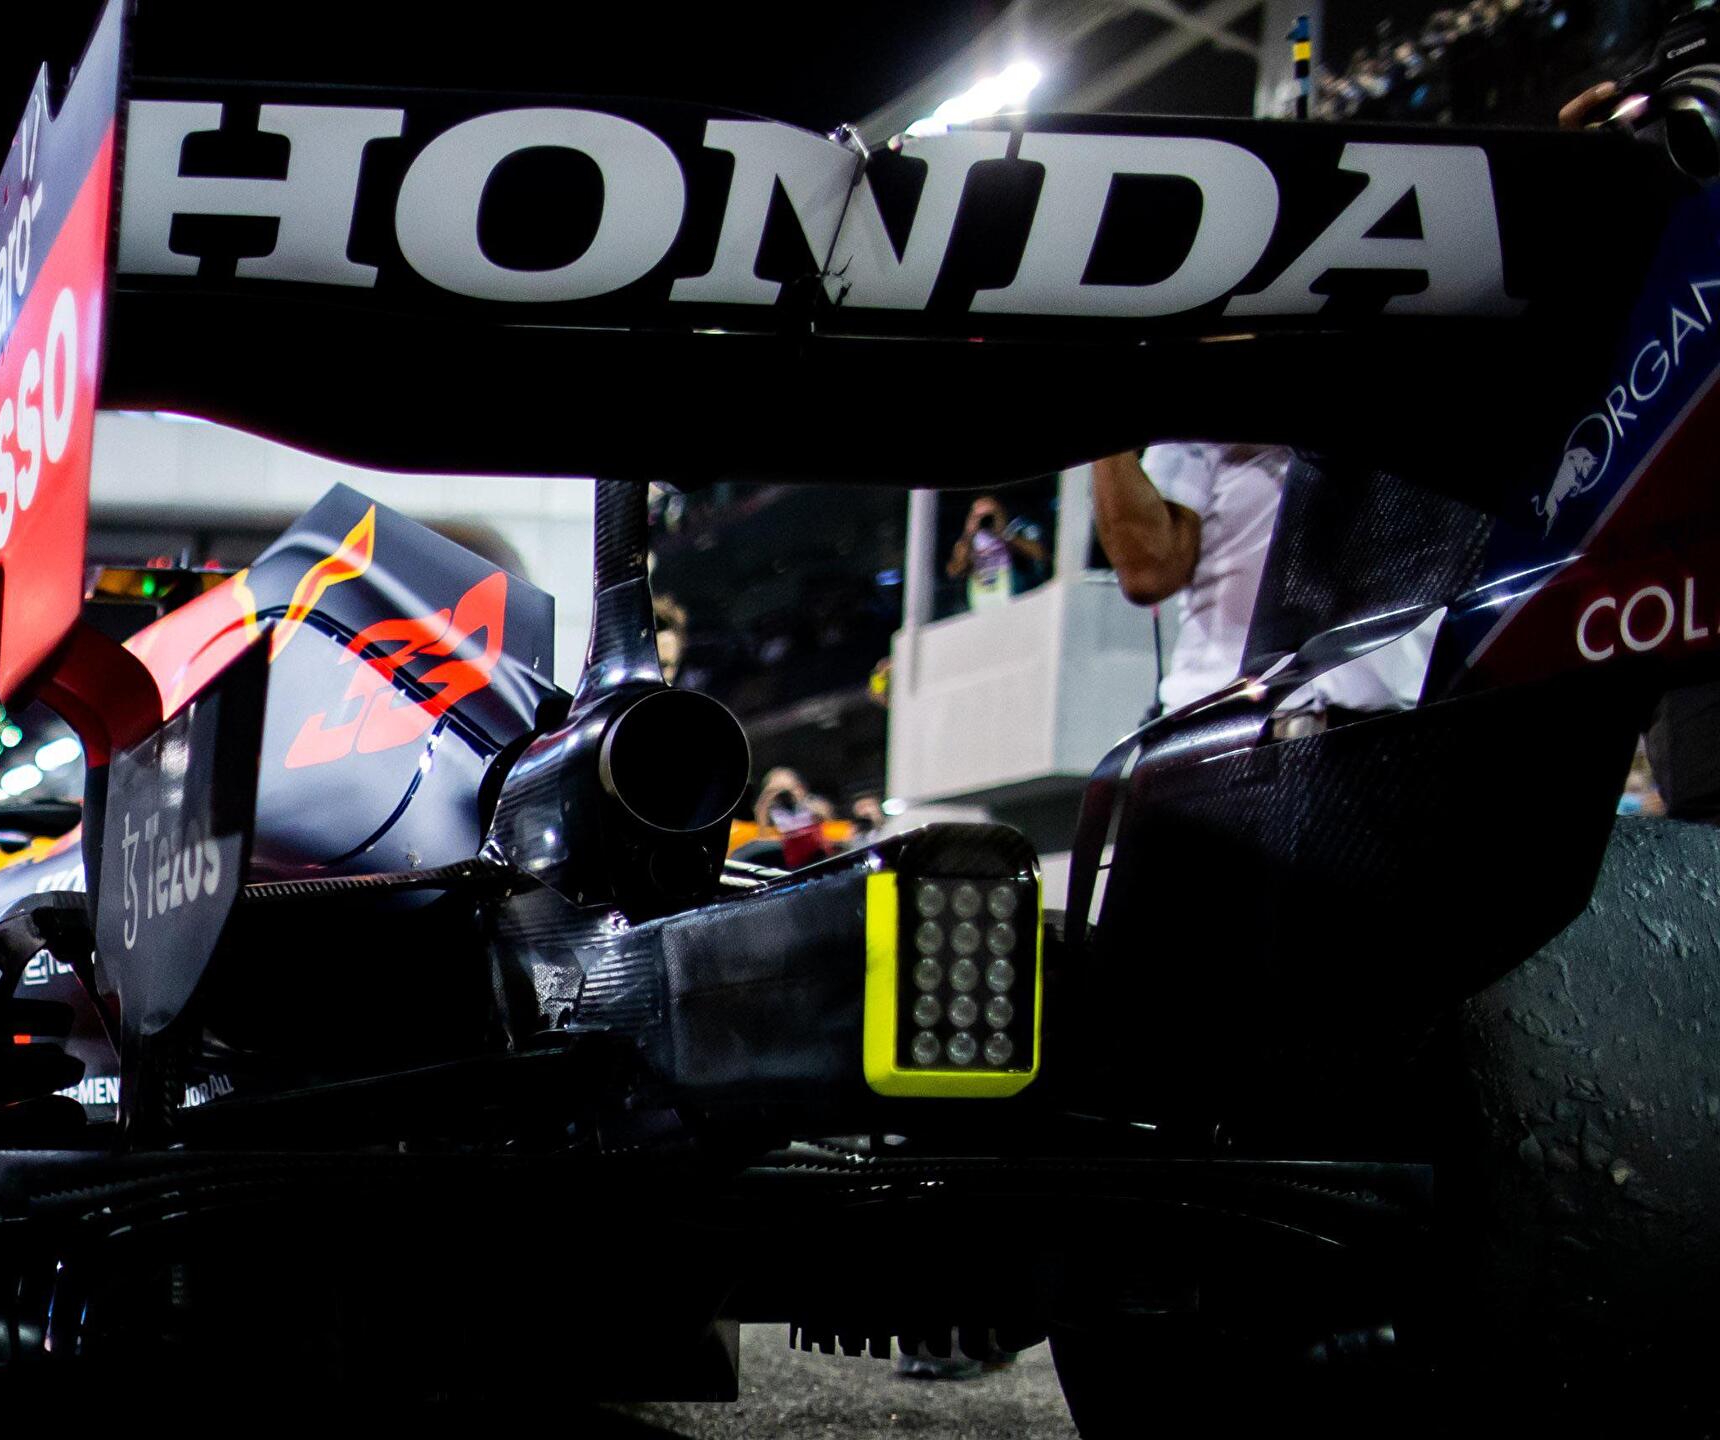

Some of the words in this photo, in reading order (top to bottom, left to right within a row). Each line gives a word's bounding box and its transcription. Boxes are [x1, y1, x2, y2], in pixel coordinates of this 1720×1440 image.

[117, 101, 1527, 318] HONDA
[1576, 576, 1720, 661] COL
[144, 811, 221, 920] Tezos
